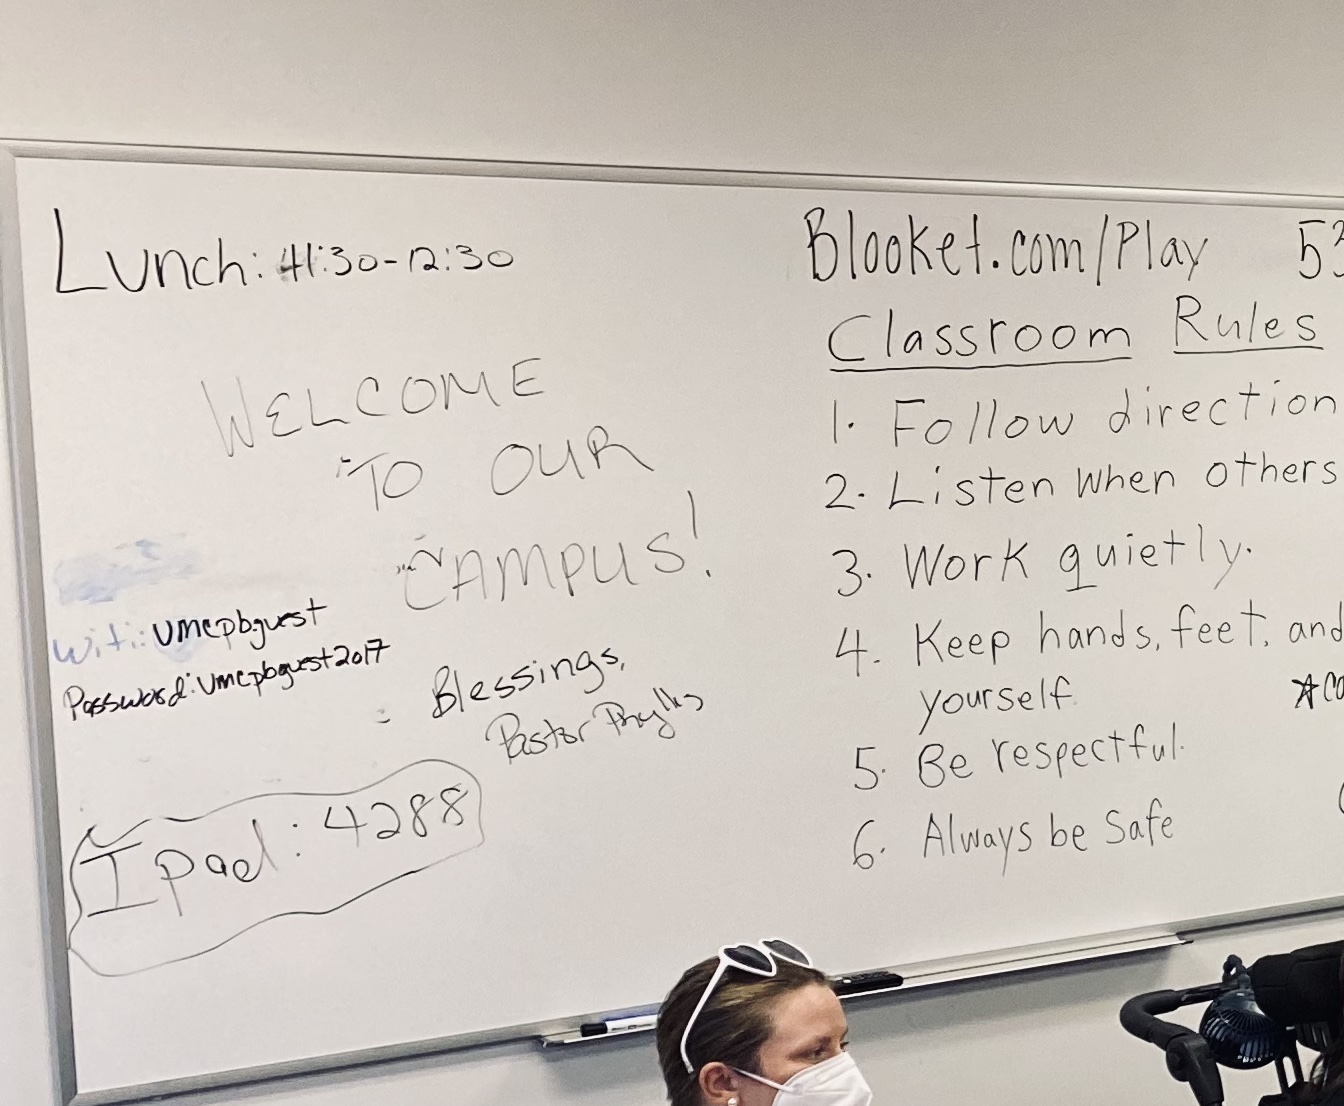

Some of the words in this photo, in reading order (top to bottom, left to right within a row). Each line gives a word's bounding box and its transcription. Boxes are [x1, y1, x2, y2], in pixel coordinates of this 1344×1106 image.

[53, 208, 262, 293] Lunch:
[804, 207, 1208, 286] Blooket.com/Play
[828, 309, 1133, 363] Classroom
[1173, 294, 1318, 346] Rules
[201, 358, 544, 463] WELCOME
[833, 398, 856, 447] 1.
[894, 399, 1073, 447] Follow
[347, 453, 423, 511] TO
[491, 426, 655, 495] OUR
[825, 473, 865, 510] 2.
[888, 466, 1054, 510] Listen
[1077, 464, 1175, 498] when
[1206, 451, 1337, 487] others
[396, 490, 711, 610] CAMPUS!
[832, 549, 871, 597] 3.
[904, 538, 1028, 589] Work
[915, 619, 1010, 666] Keep
[1289, 601, 1342, 643] and
[485, 713, 590, 765] Pastor
[854, 747, 886, 790] 5.
[918, 743, 973, 788] Be
[324, 783, 469, 849] 4288
[853, 820, 885, 870] 6.
[924, 813, 1032, 877] Always
[1050, 812, 1088, 851] be
